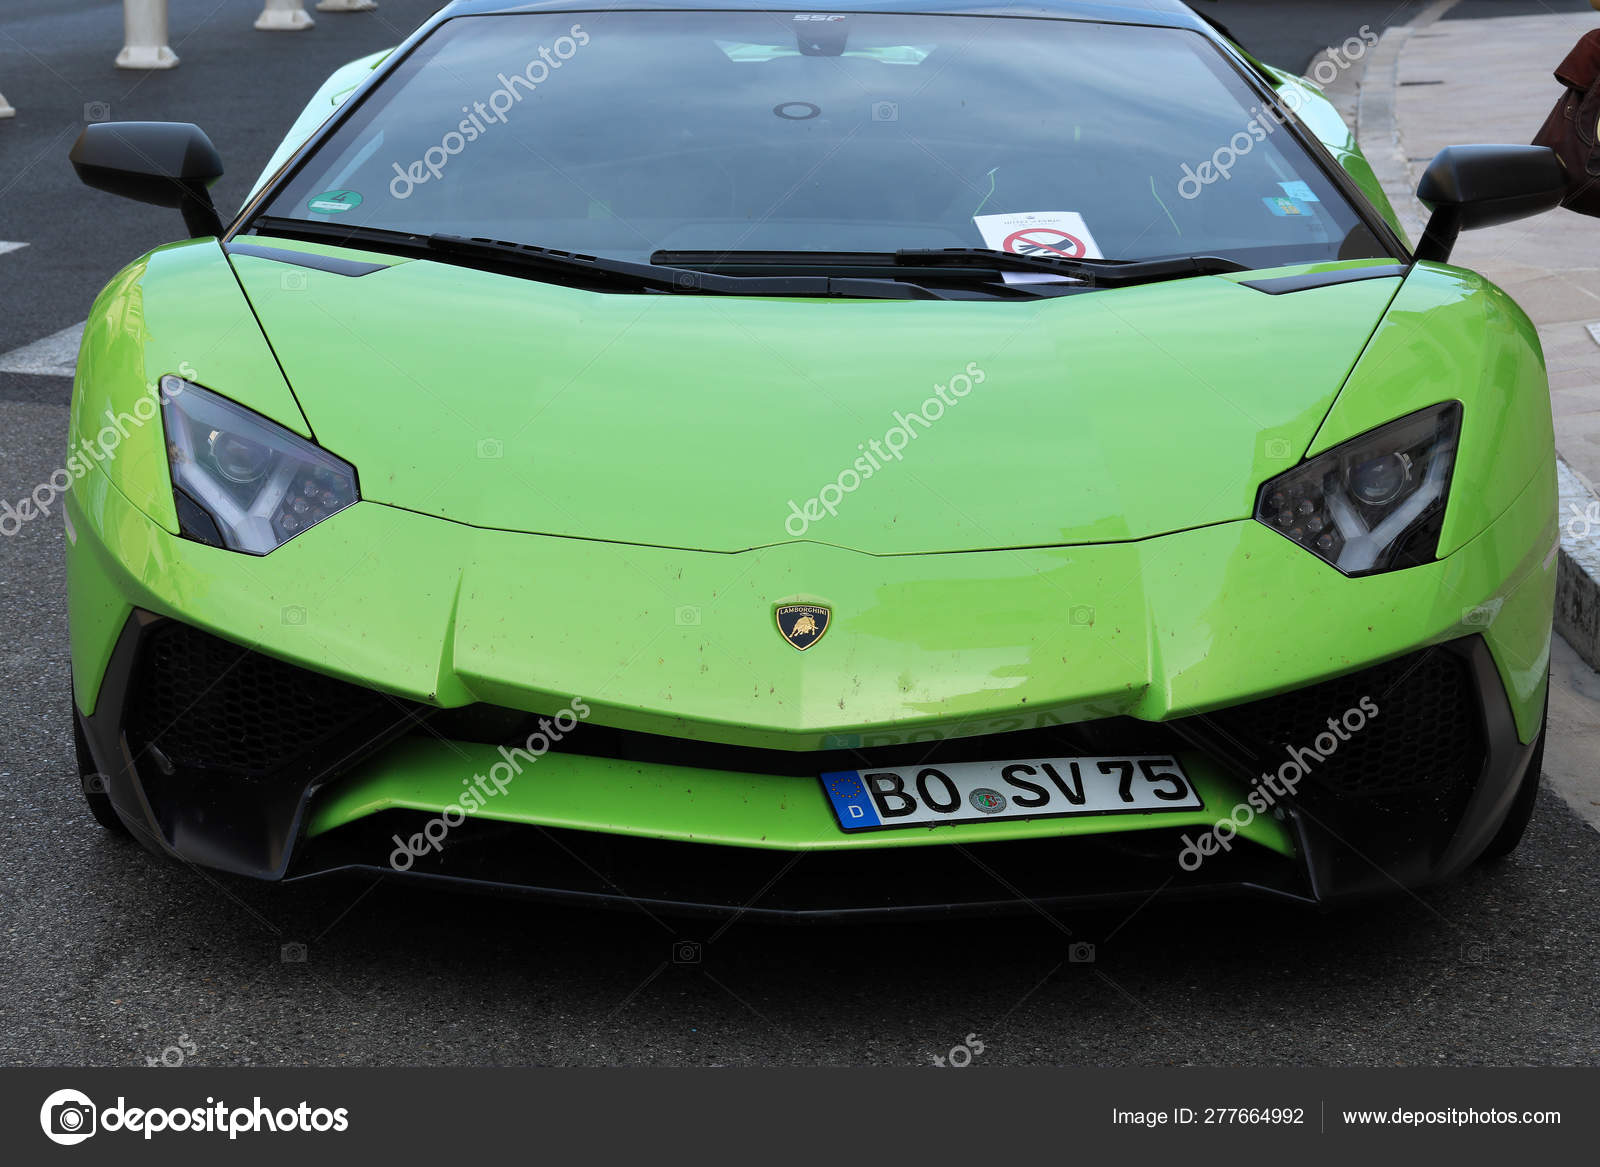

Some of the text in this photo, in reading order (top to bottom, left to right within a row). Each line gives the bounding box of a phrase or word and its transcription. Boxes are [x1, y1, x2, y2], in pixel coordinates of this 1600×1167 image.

[780, 607, 827, 616] LAMBORGHINI
[864, 768, 962, 818] BO
[1001, 762, 1088, 808] SV
[1096, 759, 1189, 803] 75
[849, 805, 864, 819] D
